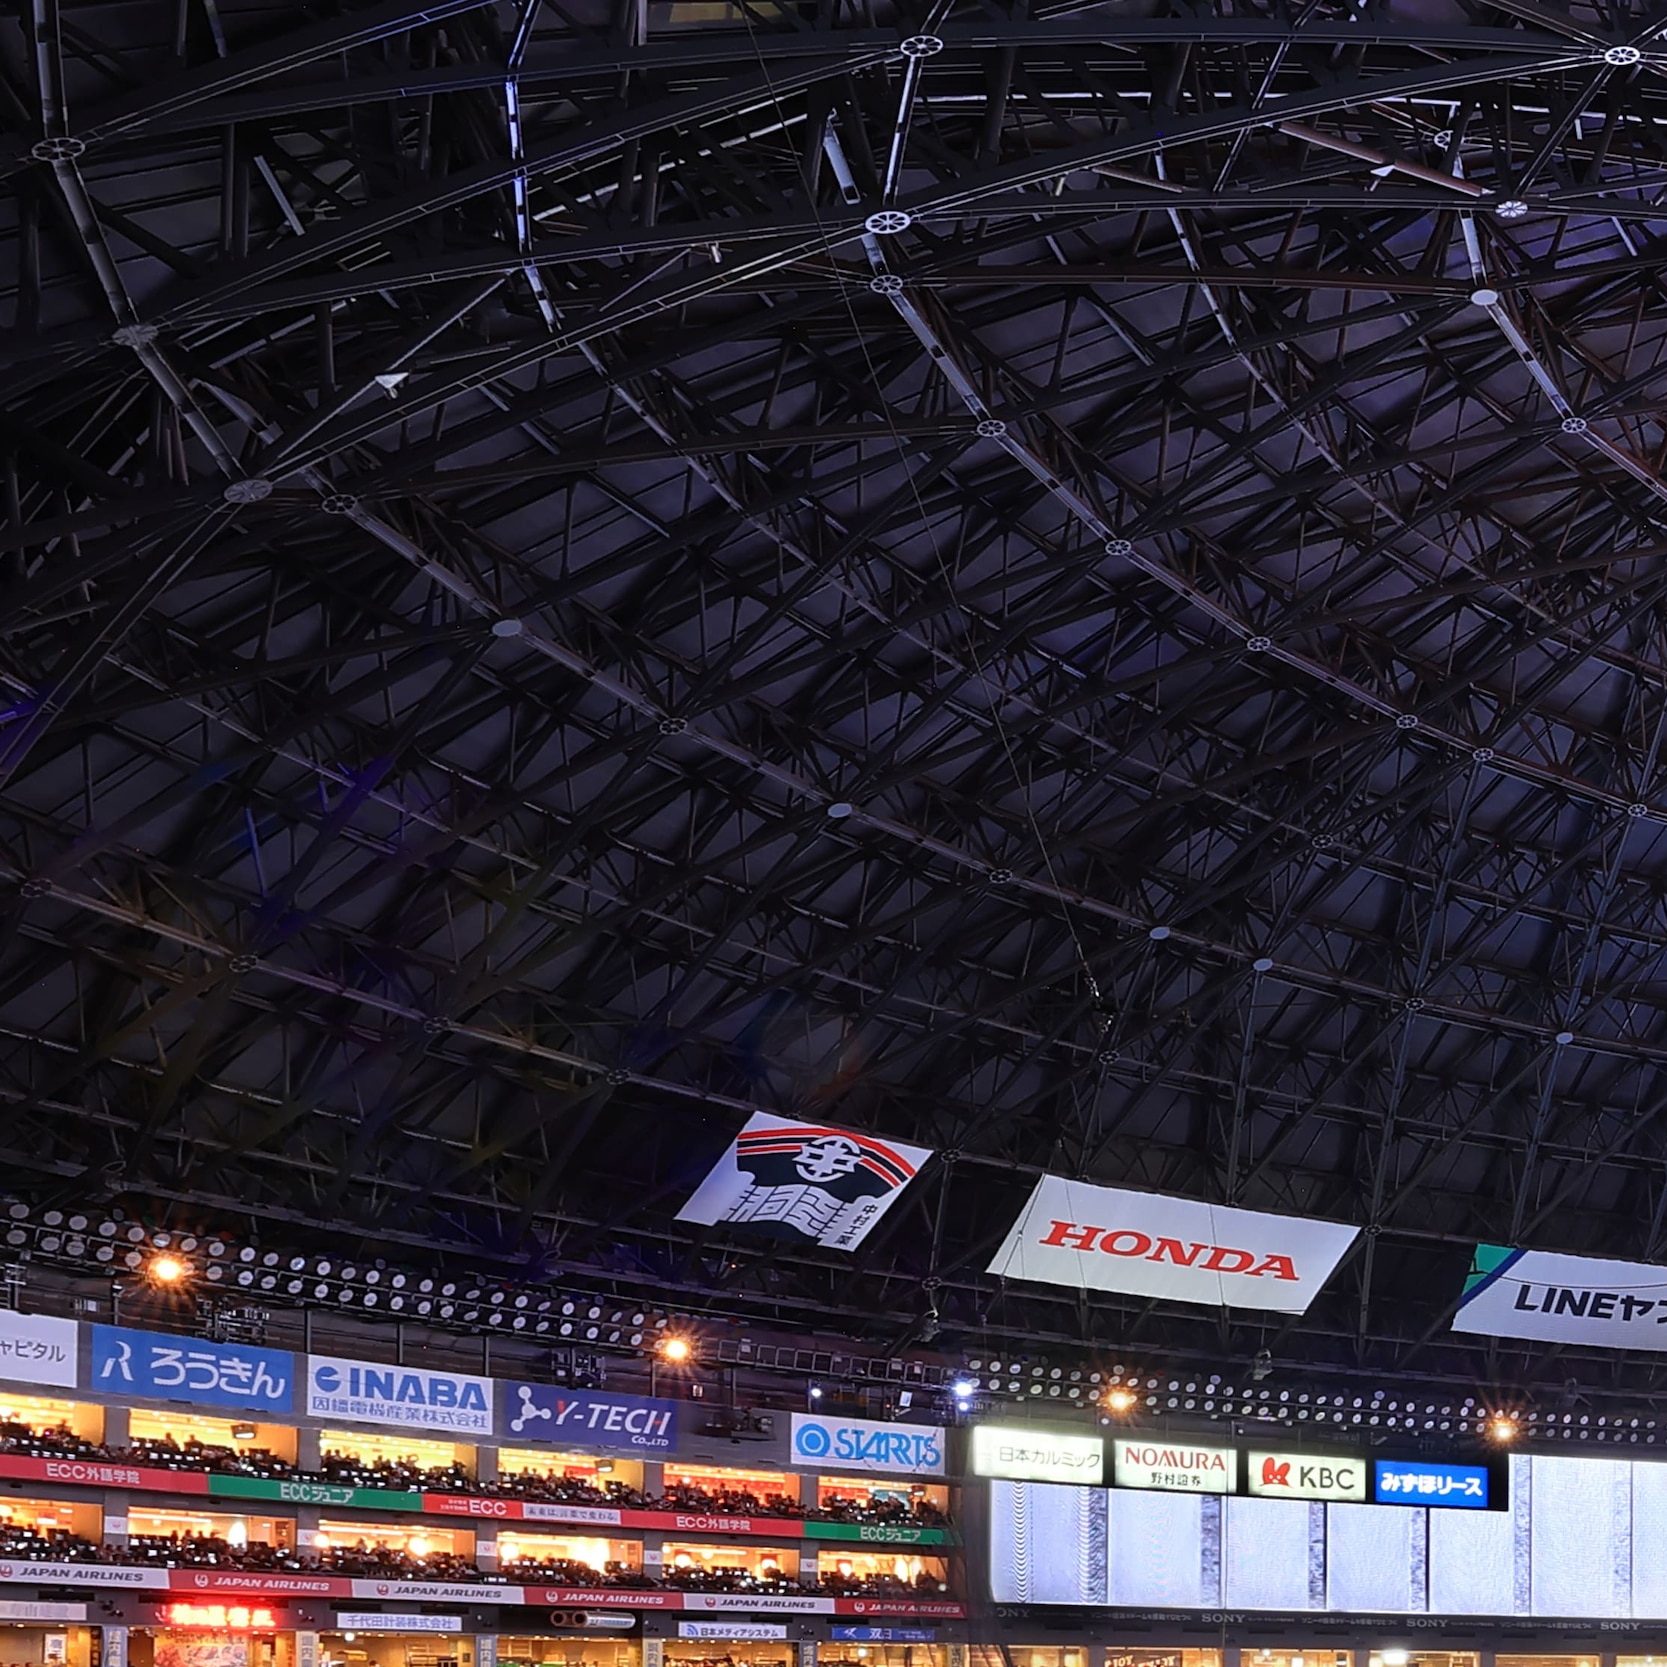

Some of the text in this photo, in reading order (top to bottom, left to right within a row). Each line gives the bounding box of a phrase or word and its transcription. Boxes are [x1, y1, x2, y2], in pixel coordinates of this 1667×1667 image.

[1039, 1220, 1300, 1280] HONDA
[150, 1346, 286, 1400] ろうきん
[350, 1367, 488, 1411] INABA
[554, 1400, 672, 1436] Y-TECH
[834, 1427, 941, 1466] STARTS
[1125, 1446, 1225, 1472] NOMURA
[46, 1463, 140, 1485] ECC外語学院
[1300, 1465, 1355, 1491] KBC
[280, 1483, 354, 1504] ECCジュニア
[1380, 1474, 1483, 1498] みずほリース
[469, 1500, 507, 1516] ECC
[676, 1515, 751, 1532] ECC外語学院
[861, 1527, 922, 1543] ECCジュニア
[20, 1567, 143, 1582] JAPAN AIRLINES
[214, 1577, 329, 1592] JAPAN AIRLINES
[394, 1586, 502, 1598] JAPAN AIRLINES
[561, 1592, 664, 1605] JAPAN AIRLINES
[720, 1598, 815, 1609] JAPAN AIRLINES
[1201, 1612, 1246, 1624] SONY
[1406, 1618, 1448, 1628] SONY
[1600, 1621, 1640, 1631] SONY
